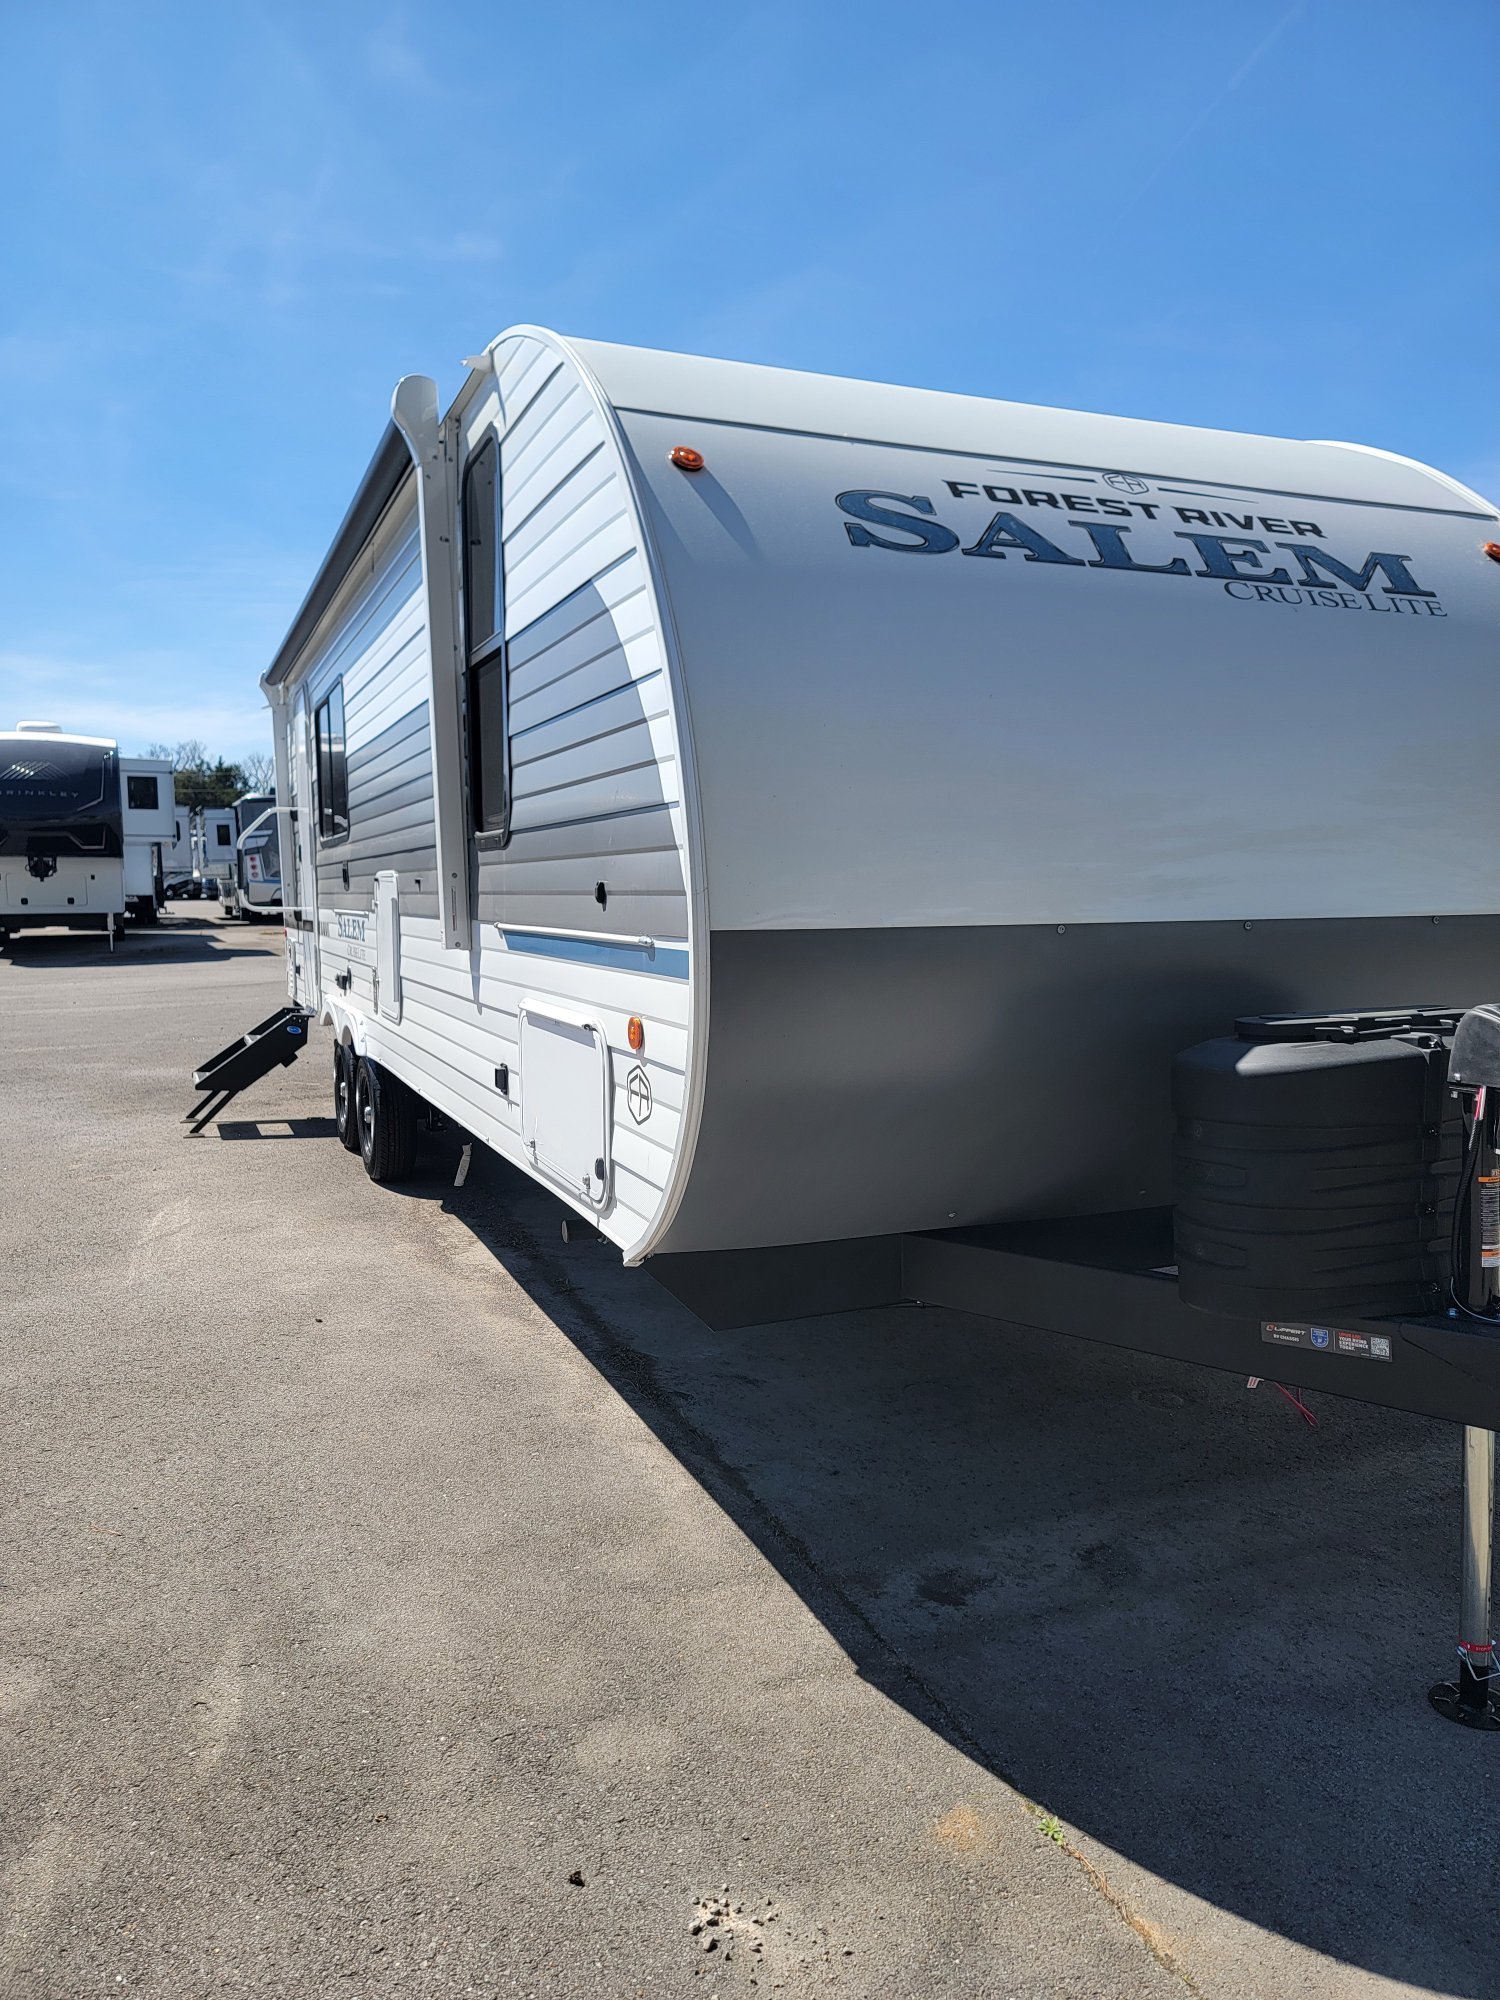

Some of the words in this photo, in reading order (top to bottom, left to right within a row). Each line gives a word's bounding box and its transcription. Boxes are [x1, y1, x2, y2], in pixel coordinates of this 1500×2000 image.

[941, 480, 1160, 520] FOREST
[1170, 506, 1328, 539] RIVER
[834, 489, 1438, 598] SALEM
[0, 790, 79, 798] RINKLEY
[338, 915, 365, 942] SALEM
